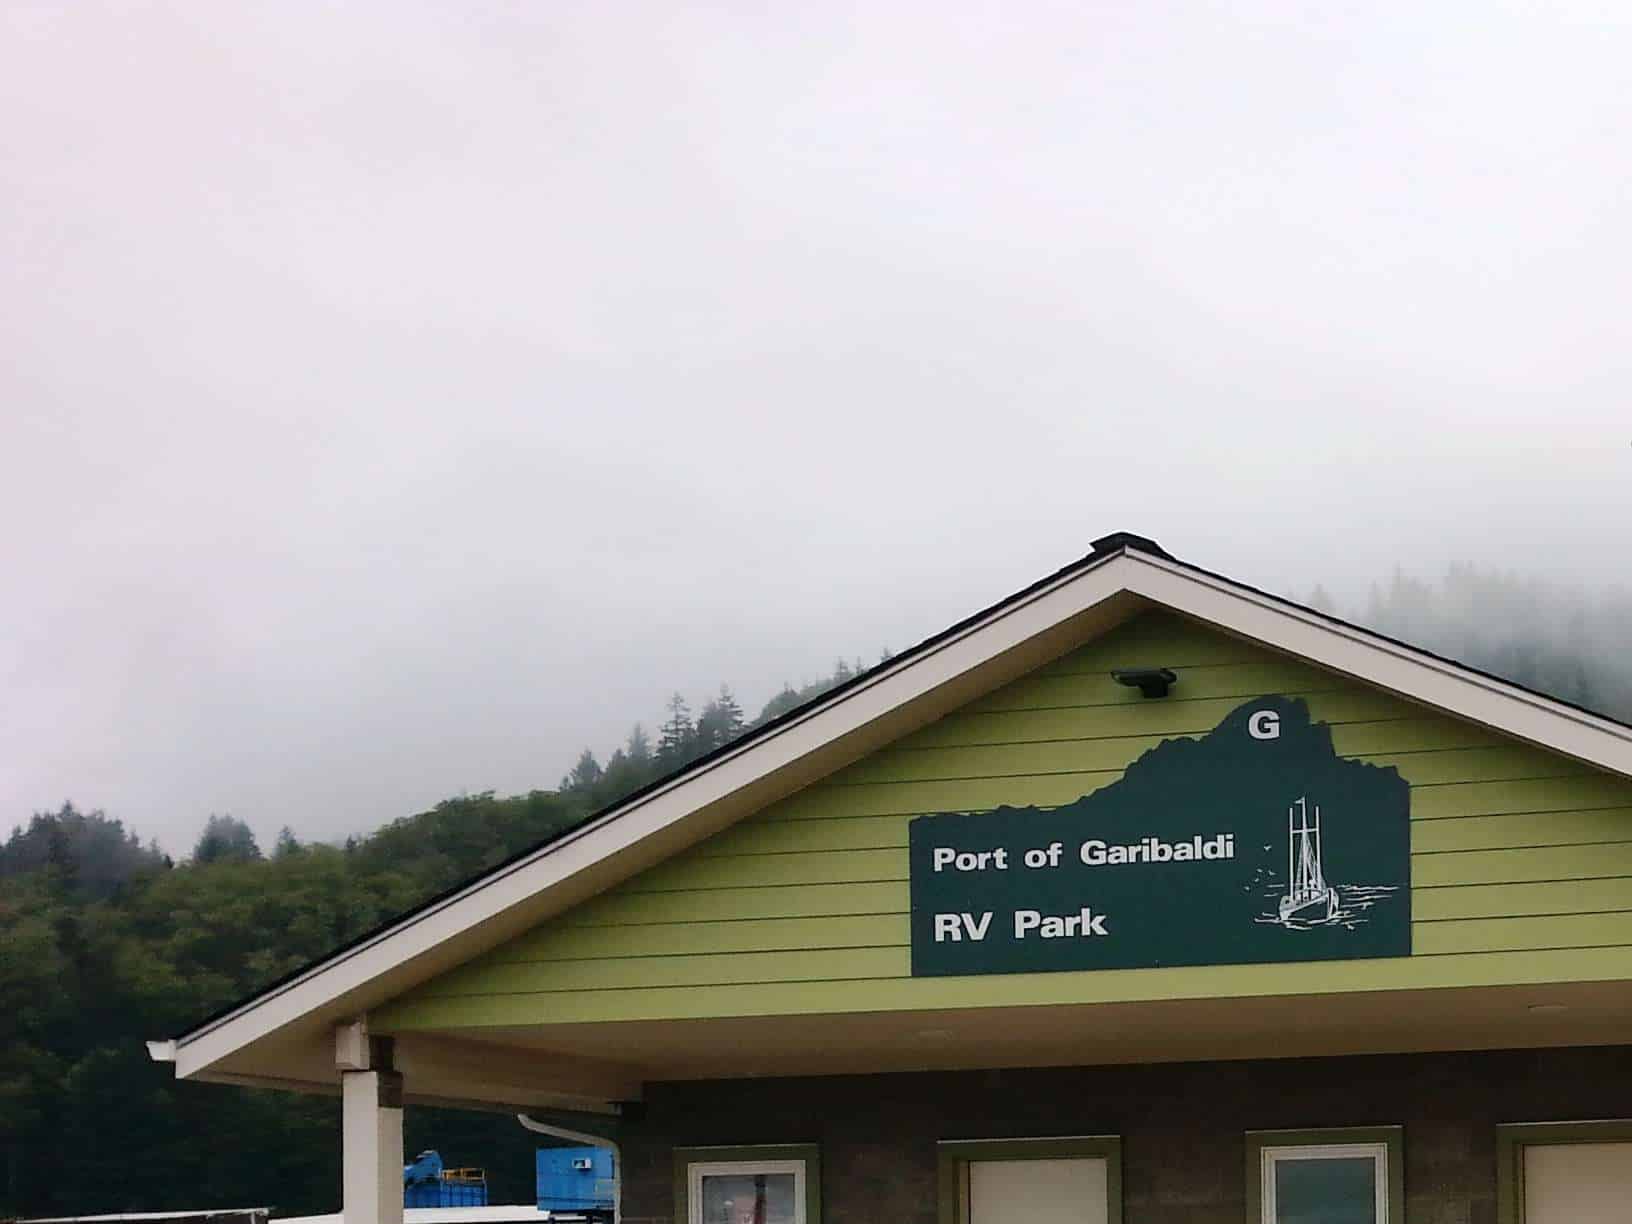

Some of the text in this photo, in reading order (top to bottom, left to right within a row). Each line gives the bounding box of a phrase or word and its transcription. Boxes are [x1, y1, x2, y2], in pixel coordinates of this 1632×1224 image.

[1249, 711, 1280, 740] G
[934, 834, 1234, 872] Port of Garibaldi
[935, 908, 1109, 942] RV Park
